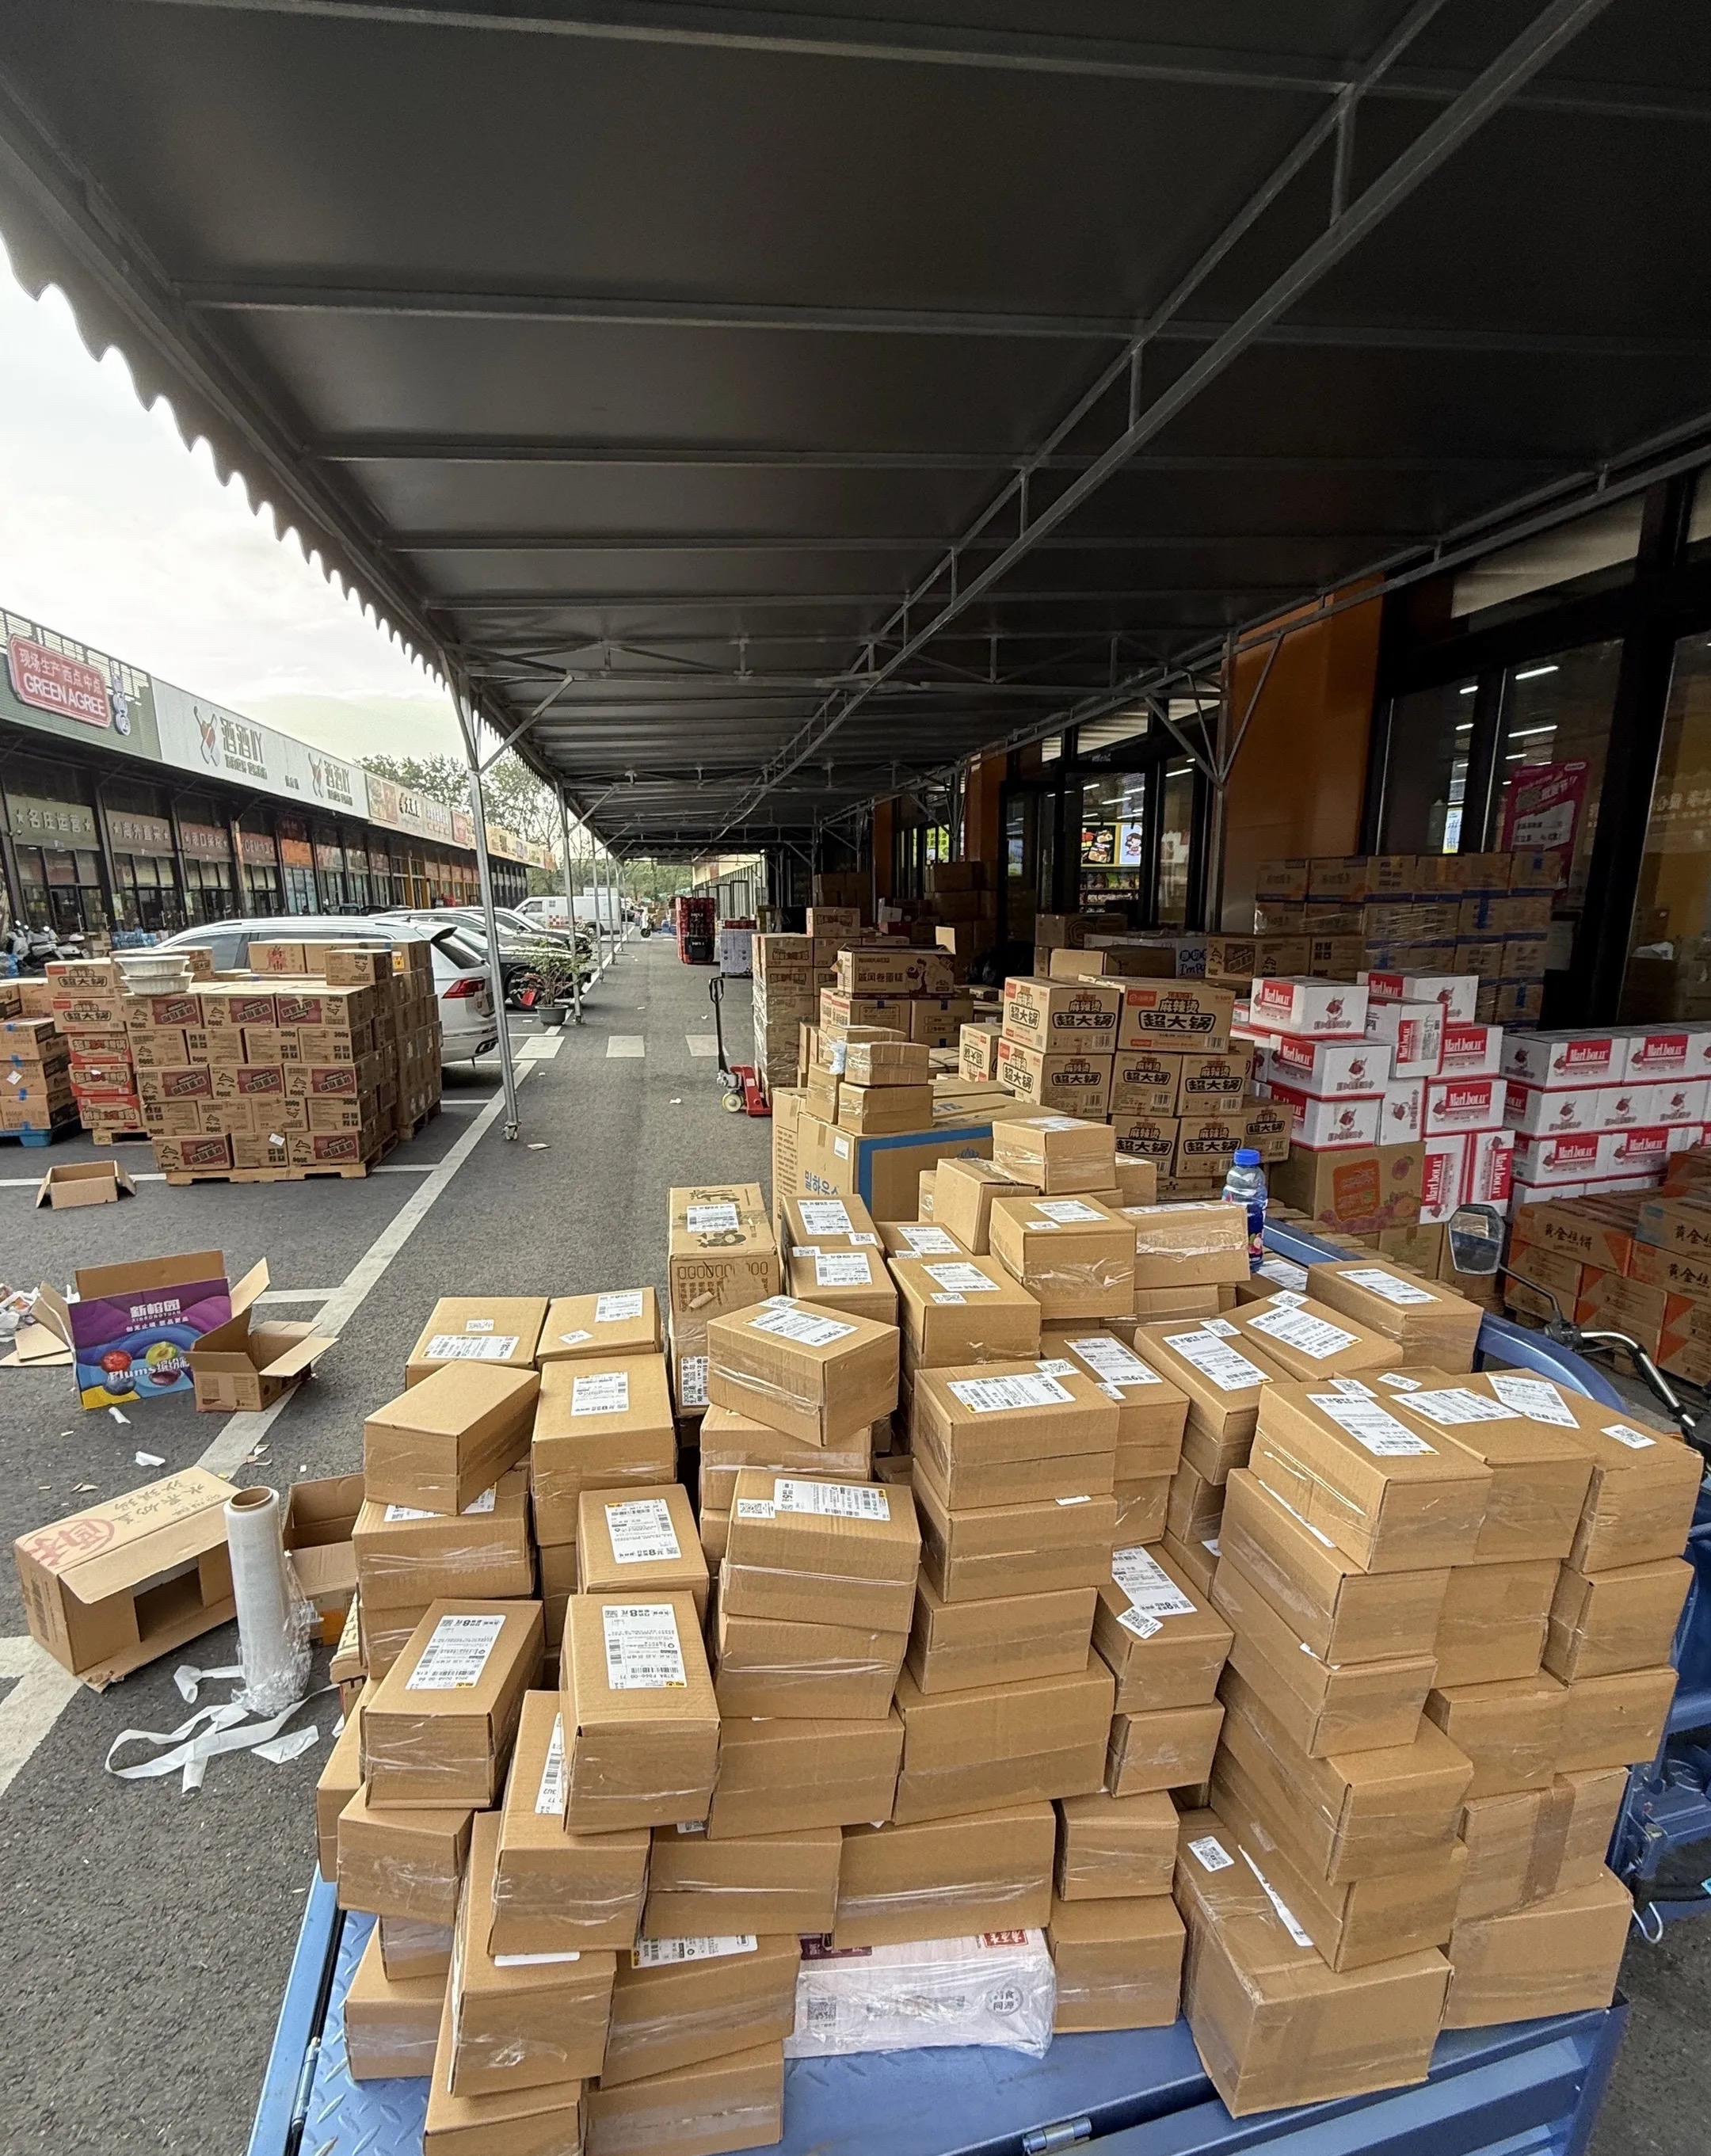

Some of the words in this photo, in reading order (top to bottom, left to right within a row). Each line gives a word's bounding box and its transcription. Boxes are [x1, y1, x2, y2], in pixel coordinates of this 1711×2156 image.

[23, 672, 67, 703] GREEN
[68, 688, 106, 717] AGREE
[1056, 1015, 1113, 1027] 超大锅
[1143, 1014, 1212, 1030] 超大锅
[1054, 1074, 1099, 1084] 超大锅
[1126, 1072, 1168, 1084] 超大锅
[1188, 1080, 1240, 1091] 超大锅
[1116, 1141, 1170, 1152] 超大锅
[1187, 1141, 1240, 1152] 超大锅
[109, 1365, 156, 1381] Plums
